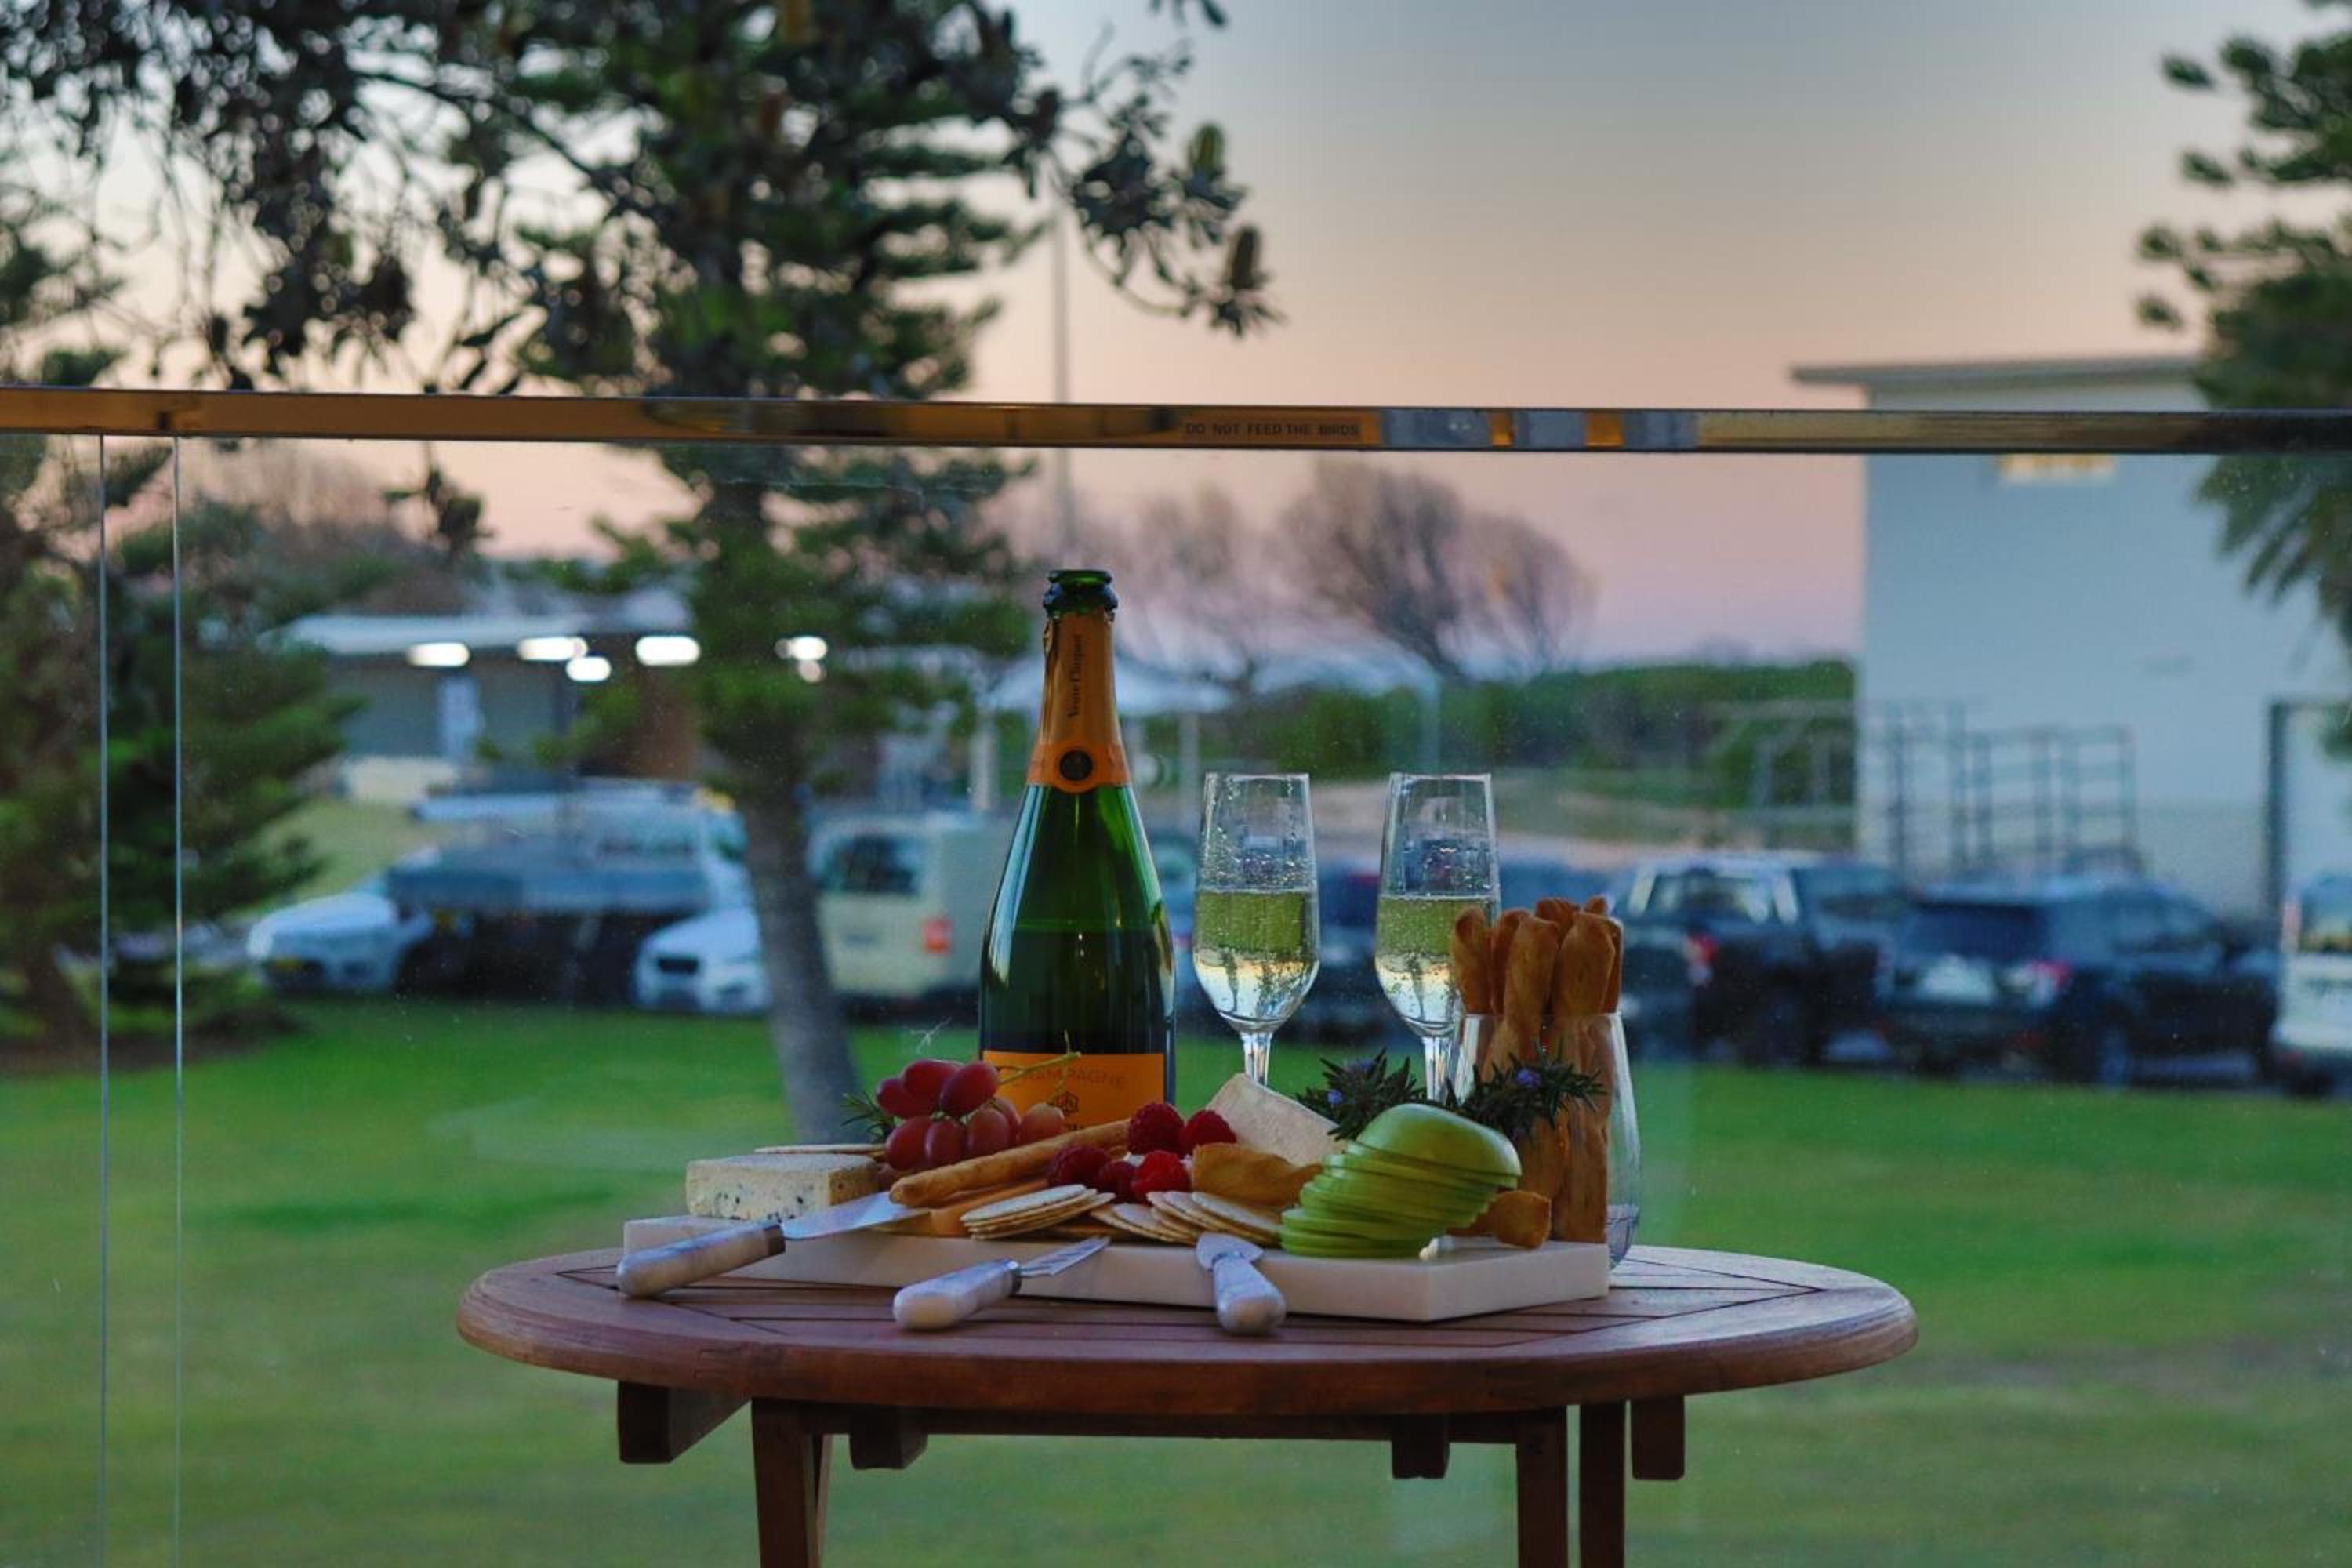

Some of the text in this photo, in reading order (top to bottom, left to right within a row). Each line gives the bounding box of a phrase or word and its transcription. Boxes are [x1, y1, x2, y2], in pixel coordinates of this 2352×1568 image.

[1185, 423, 1359, 436] DO NOT FEED THE BIRDS
